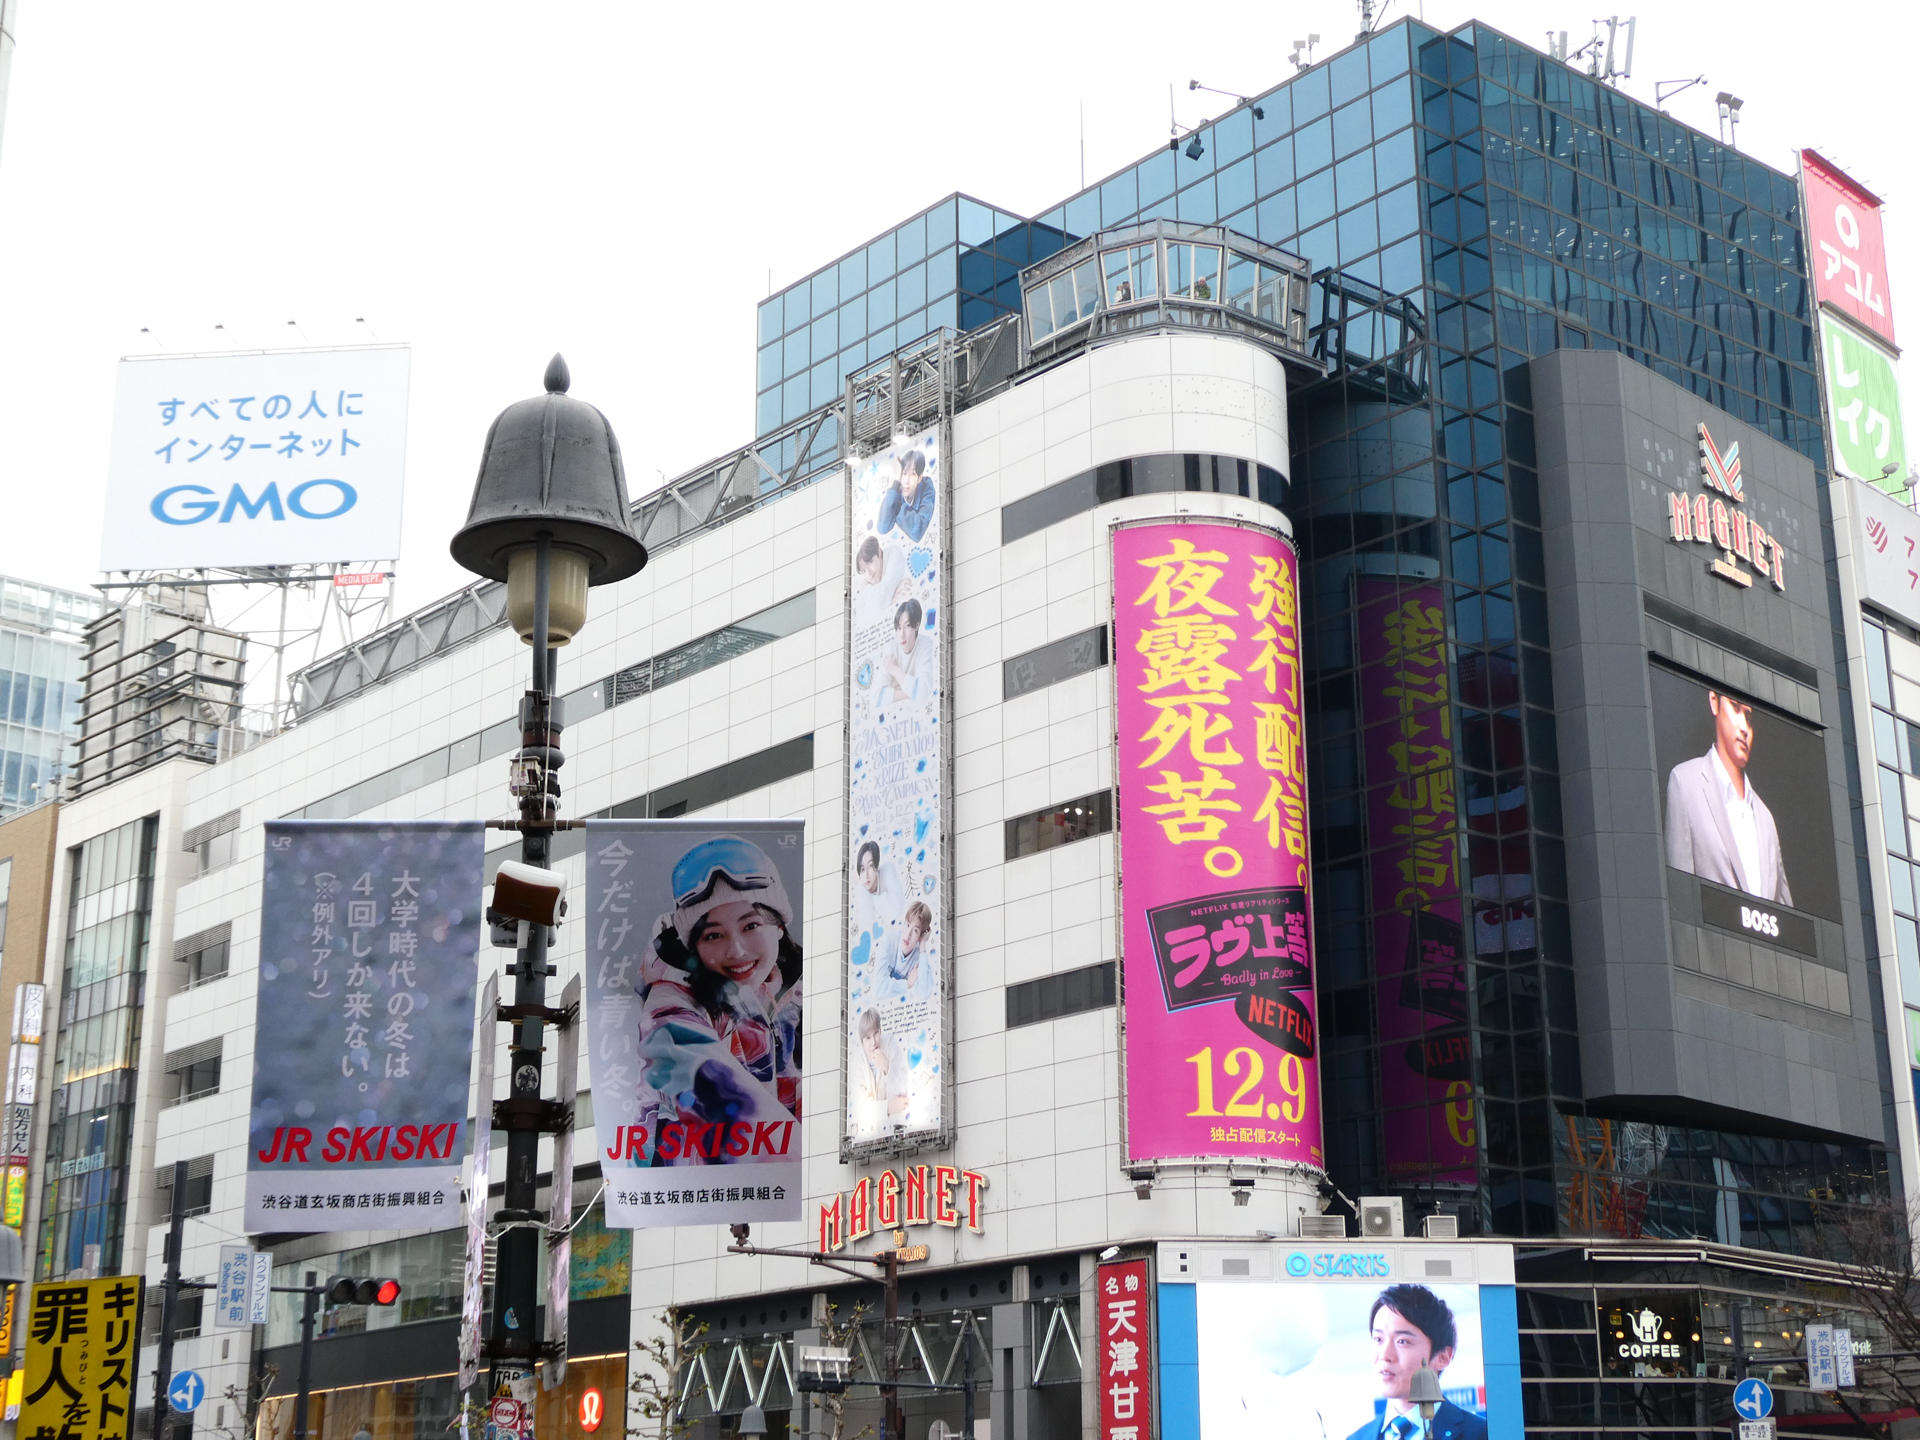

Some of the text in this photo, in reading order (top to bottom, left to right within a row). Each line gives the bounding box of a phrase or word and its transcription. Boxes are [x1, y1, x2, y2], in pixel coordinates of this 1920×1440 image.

[1820, 239, 1885, 317] アコム
[157, 390, 364, 426] すべての人に
[1832, 334, 1891, 460] レイク
[154, 428, 361, 464] インターネット
[150, 478, 358, 526] GMO
[1670, 492, 1785, 591] MAGNET
[338, 575, 360, 585] MEDIA
[1133, 538, 1245, 878] 夜露死苦。
[1247, 554, 1308, 894] 強行配信。
[271, 836, 292, 848] JR
[777, 834, 797, 846] JR
[1190, 904, 1229, 917] NETFLIX
[1740, 906, 1779, 937] BOSS
[342, 871, 377, 1093] 4回しか来ない。
[385, 870, 421, 1078] 大学時代の冬は
[1220, 967, 1294, 987] Badly in Love
[24, 986, 42, 1034] 皮ふ科
[1248, 994, 1313, 1052] NETFLIX
[17, 1066, 34, 1100] 内科
[1185, 1046, 1306, 1123] 12.9
[11, 1106, 31, 1154] 処方せん
[258, 1122, 460, 1163] JR SKISKI
[606, 1121, 796, 1161] JR SKISKI
[1210, 1126, 1301, 1147] 独占配信スタート
[262, 1190, 445, 1210] 渋谷道玄坂商店街振興組合
[617, 1185, 786, 1206] 渋谷道玄坂商店街振興組合
[819, 1164, 986, 1254] MAGNET
[893, 1230, 904, 1247] by
[220, 1262, 232, 1294] Shibuya
[230, 1252, 248, 1321] 渋谷駅前
[252, 1255, 267, 1321] スクランブル式
[1105, 1274, 1139, 1295] 名物
[78, 1339, 89, 1385] つみびと
[98, 1283, 135, 1440] キリスト
[1618, 1344, 1681, 1358] COFFEE
[1818, 1330, 1833, 1384] 渋谷駅前
[1838, 1332, 1851, 1383] スクランブル式
